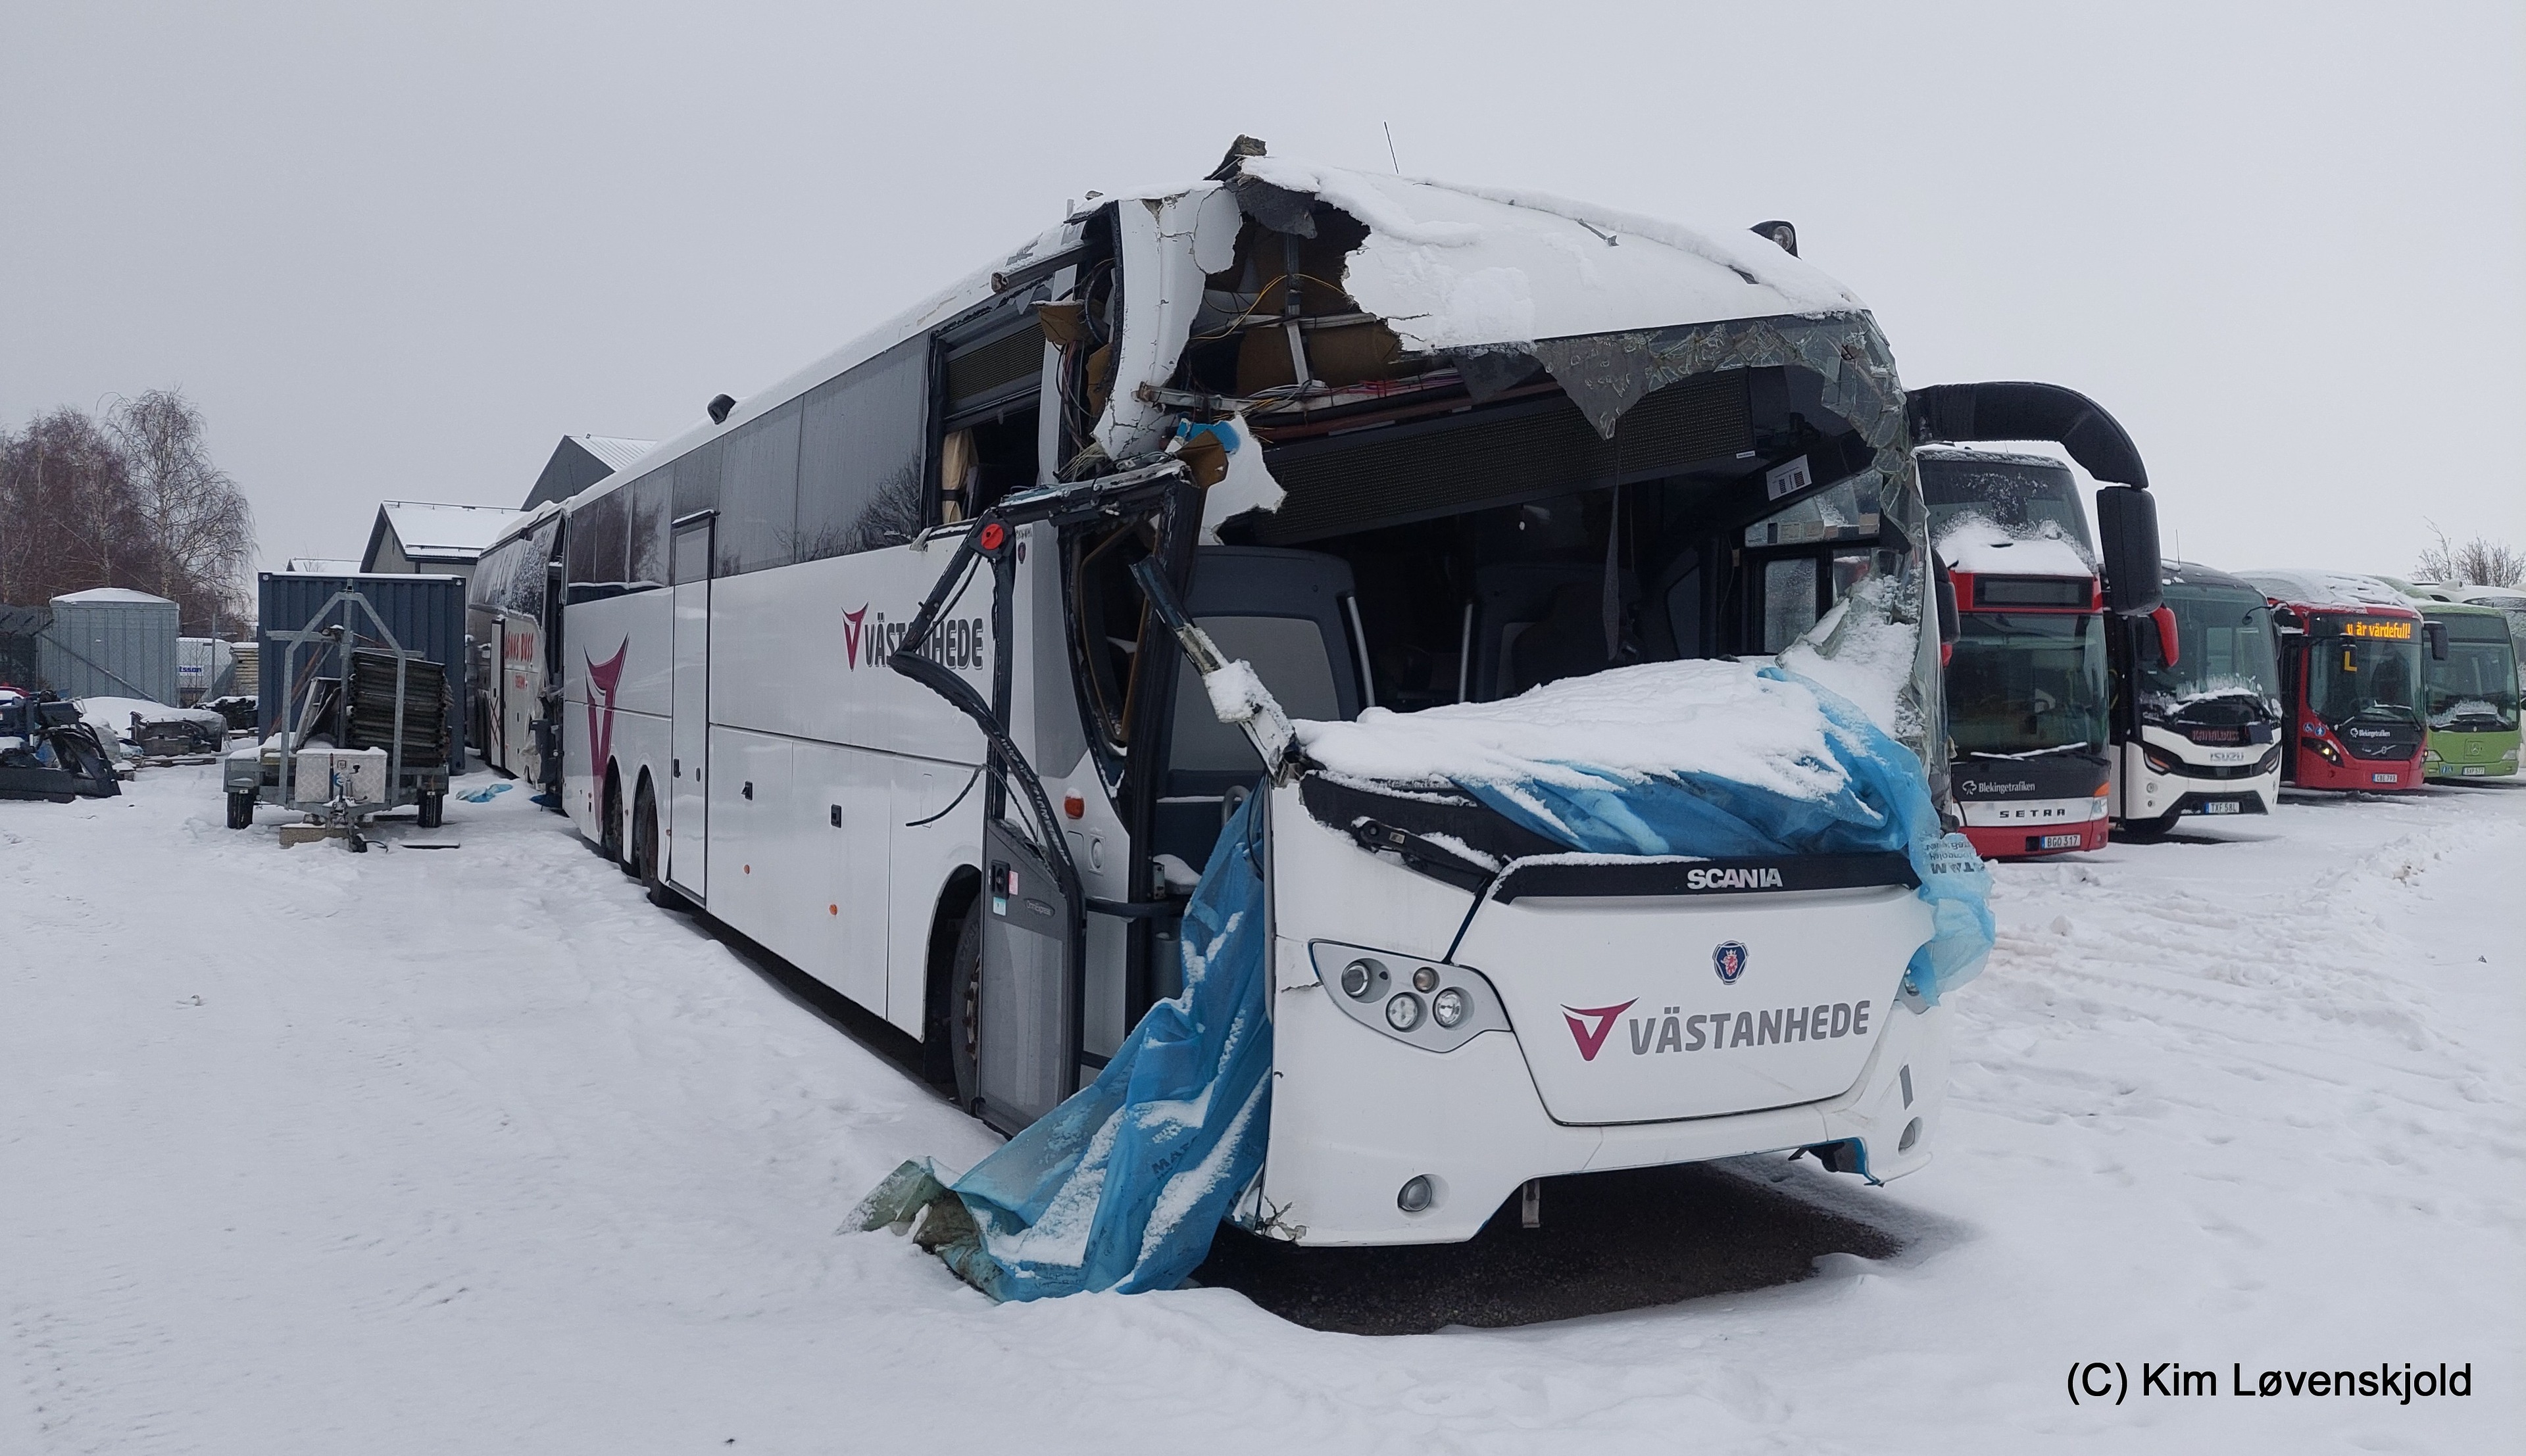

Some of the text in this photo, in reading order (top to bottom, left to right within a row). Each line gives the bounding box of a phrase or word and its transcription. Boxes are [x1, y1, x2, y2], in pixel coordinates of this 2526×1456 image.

[2356, 621, 2367, 637] är
[2368, 621, 2412, 639] värdefull!
[864, 612, 983, 669] VÄSTHEDE
[2210, 752, 2244, 762] ISUZU
[1978, 781, 2035, 794] Blekingetrafiken
[1999, 809, 2066, 818] SETRA
[2211, 803, 2223, 813] TXF
[2063, 835, 2078, 846] 317
[1687, 867, 1783, 890] SCANIA
[1629, 1000, 1871, 1056] VÄSTANHEDE
